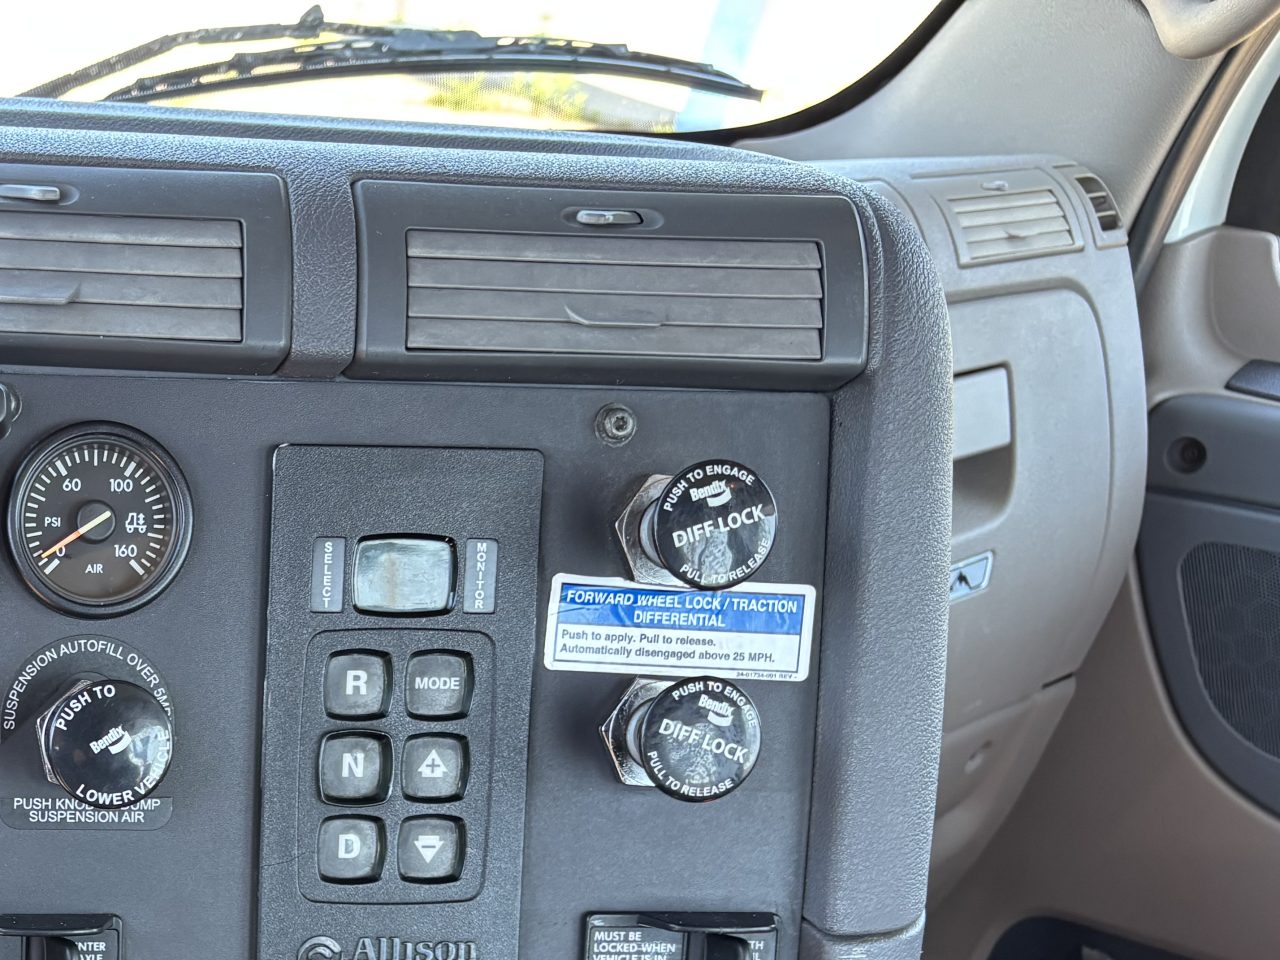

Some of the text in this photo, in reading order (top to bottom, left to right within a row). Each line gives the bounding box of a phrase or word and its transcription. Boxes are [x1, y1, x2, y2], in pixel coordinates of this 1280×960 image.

[62, 478, 82, 492] 60
[109, 479, 133, 492] 100
[663, 465, 755, 512] PUSH TO ENGAGE
[690, 479, 727, 502] Bendix
[44, 517, 61, 528] PSI
[672, 504, 765, 548] DIFF LOCK
[56, 545, 66, 557] 0
[114, 545, 137, 557] 160
[679, 538, 770, 585] PULL TO RELEASE
[85, 564, 104, 574] AIR
[322, 542, 333, 608] SELECT
[474, 543, 487, 609] MONITOR
[566, 591, 797, 613] FORWARD WHEEL LOCK / TRACTION
[633, 611, 726, 627] DIFFERENTIAL
[561, 629, 716, 646] Push to apply. Pull to release.
[560, 643, 775, 663] Automatically disengaged above 25 MPH.
[3, 639, 159, 730] SUSPENSION AUTOFILL OVER
[345, 670, 368, 695] R
[415, 677, 460, 690] MODE
[55, 684, 116, 730] PUSH TO
[672, 681, 756, 728] PUSH TO ENGAGE
[698, 694, 734, 717] Bendix
[89, 724, 127, 755] Bendix
[659, 719, 748, 764] DIFF LOCK
[76, 729, 170, 805] LOWER VEHICLE
[341, 753, 365, 778] N
[647, 751, 734, 796] PULL TO RELEASE
[13, 798, 51, 809] PUSH
[29, 811, 145, 822] SUSPENSION AIR
[338, 834, 361, 859] D
[593, 943, 676, 952] LOCKED WHEN
[594, 931, 642, 941] MUST BE
